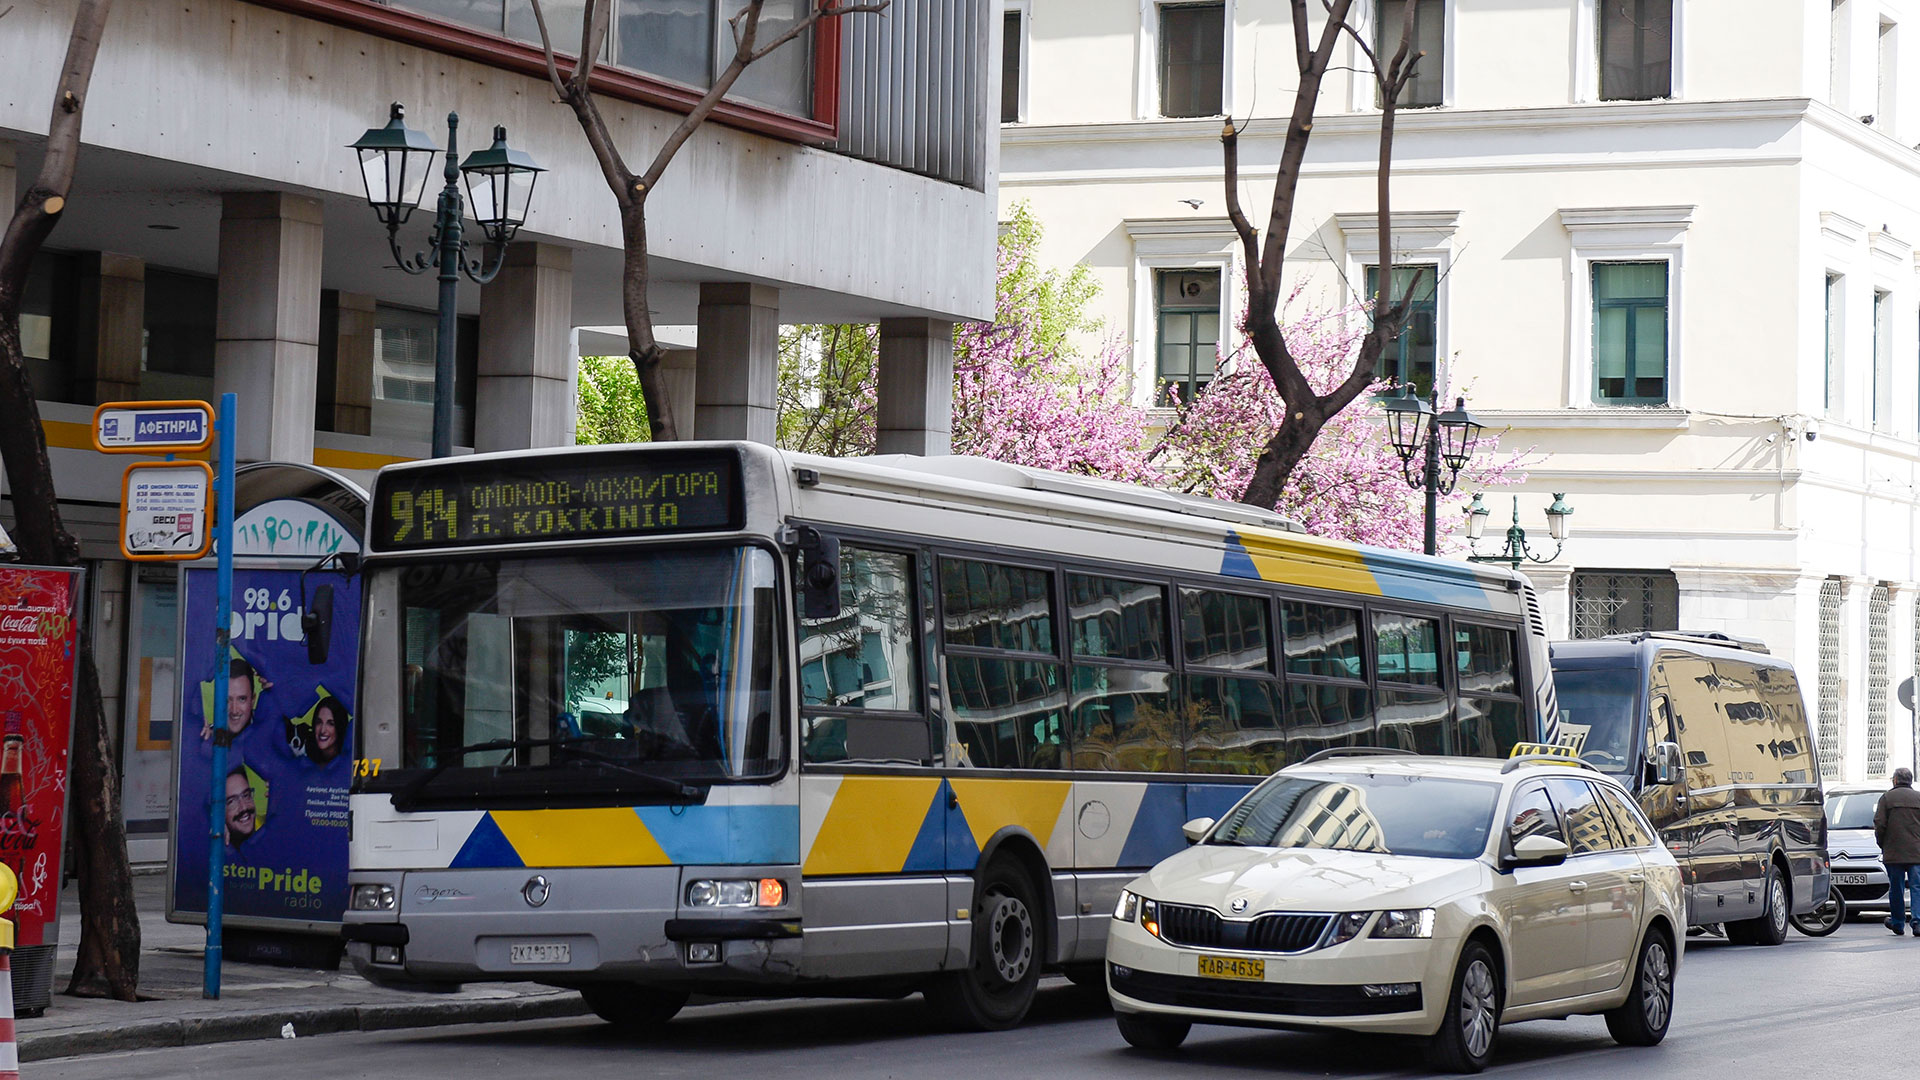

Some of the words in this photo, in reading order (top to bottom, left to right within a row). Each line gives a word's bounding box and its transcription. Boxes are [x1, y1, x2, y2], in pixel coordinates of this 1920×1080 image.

[138, 420, 198, 434] ΑΦΕΤΗΡΙΑ
[391, 488, 457, 542] 914
[513, 503, 678, 534] ΚΟΚΚΙΝΙΑ
[244, 587, 292, 612] 98.6
[1519, 744, 1568, 757] TAXI
[352, 758, 382, 777] 737
[223, 863, 256, 878] sten
[258, 867, 322, 894] Pride
[285, 893, 322, 909] radio
